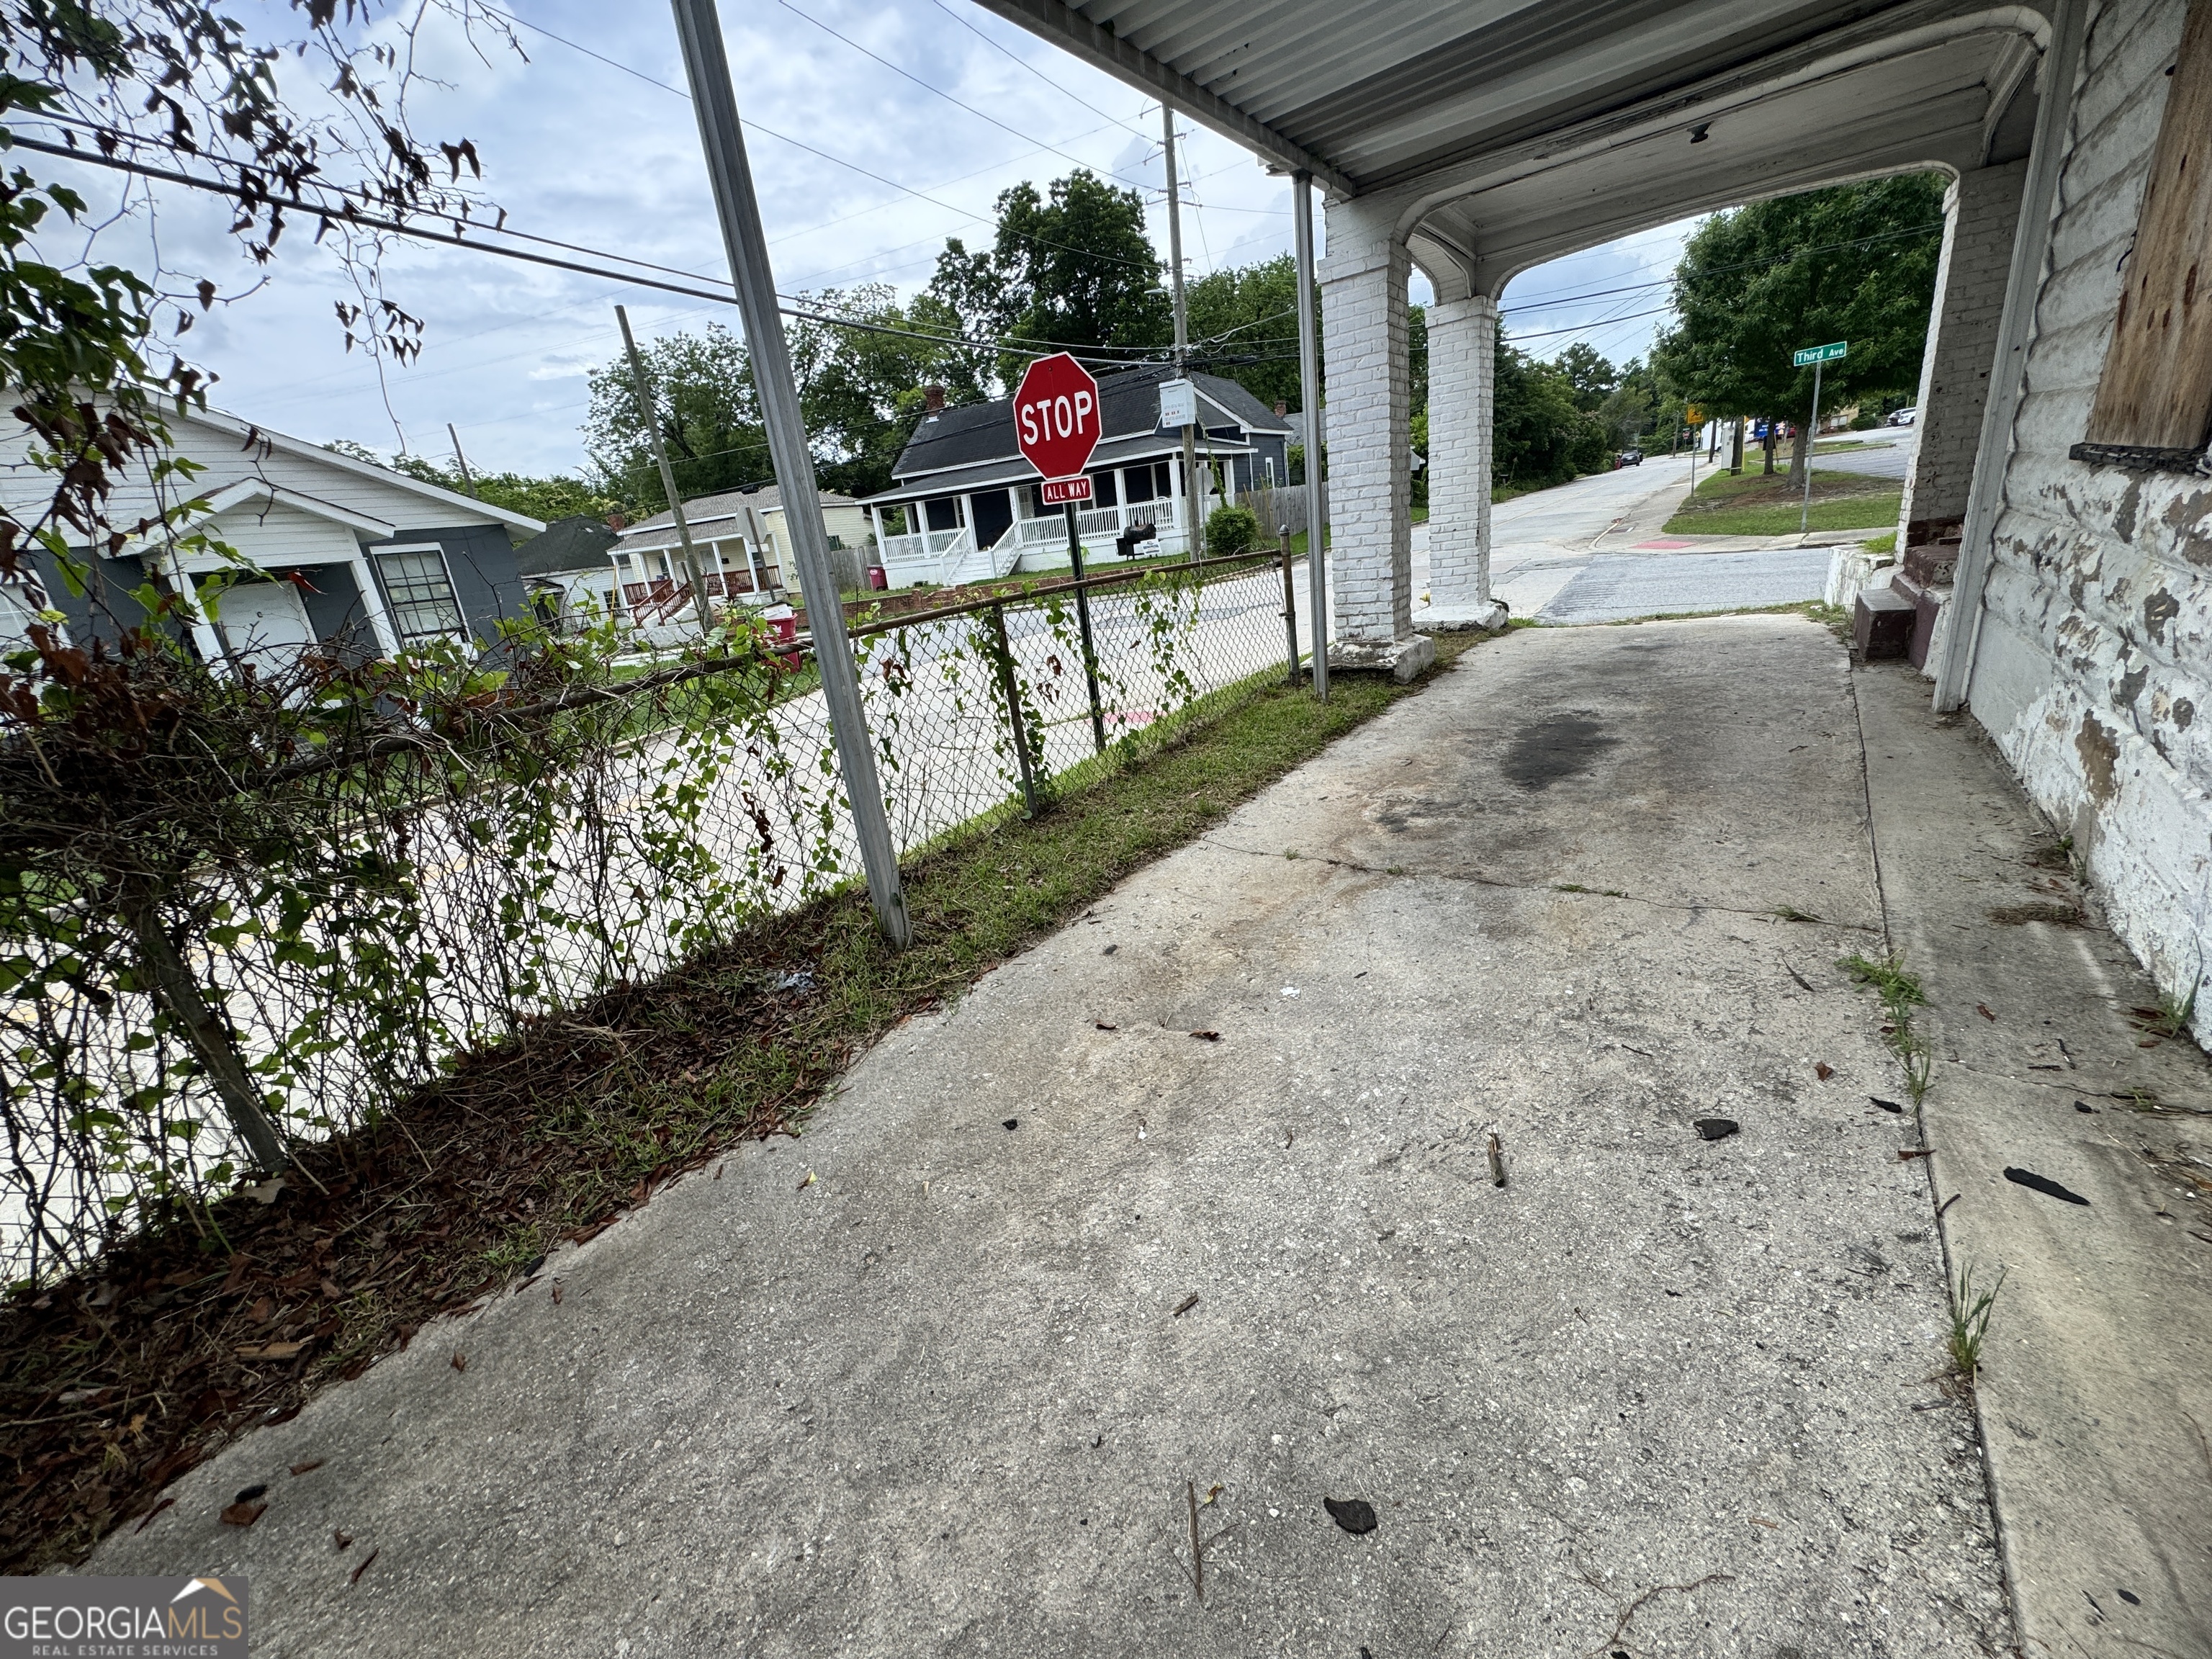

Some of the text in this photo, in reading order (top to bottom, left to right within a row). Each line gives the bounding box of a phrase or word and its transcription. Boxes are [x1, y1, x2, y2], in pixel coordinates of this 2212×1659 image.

[1797, 348, 1844, 363] Third Ave
[1021, 390, 1092, 446] STOP
[1047, 481, 1087, 500] ALL WAY
